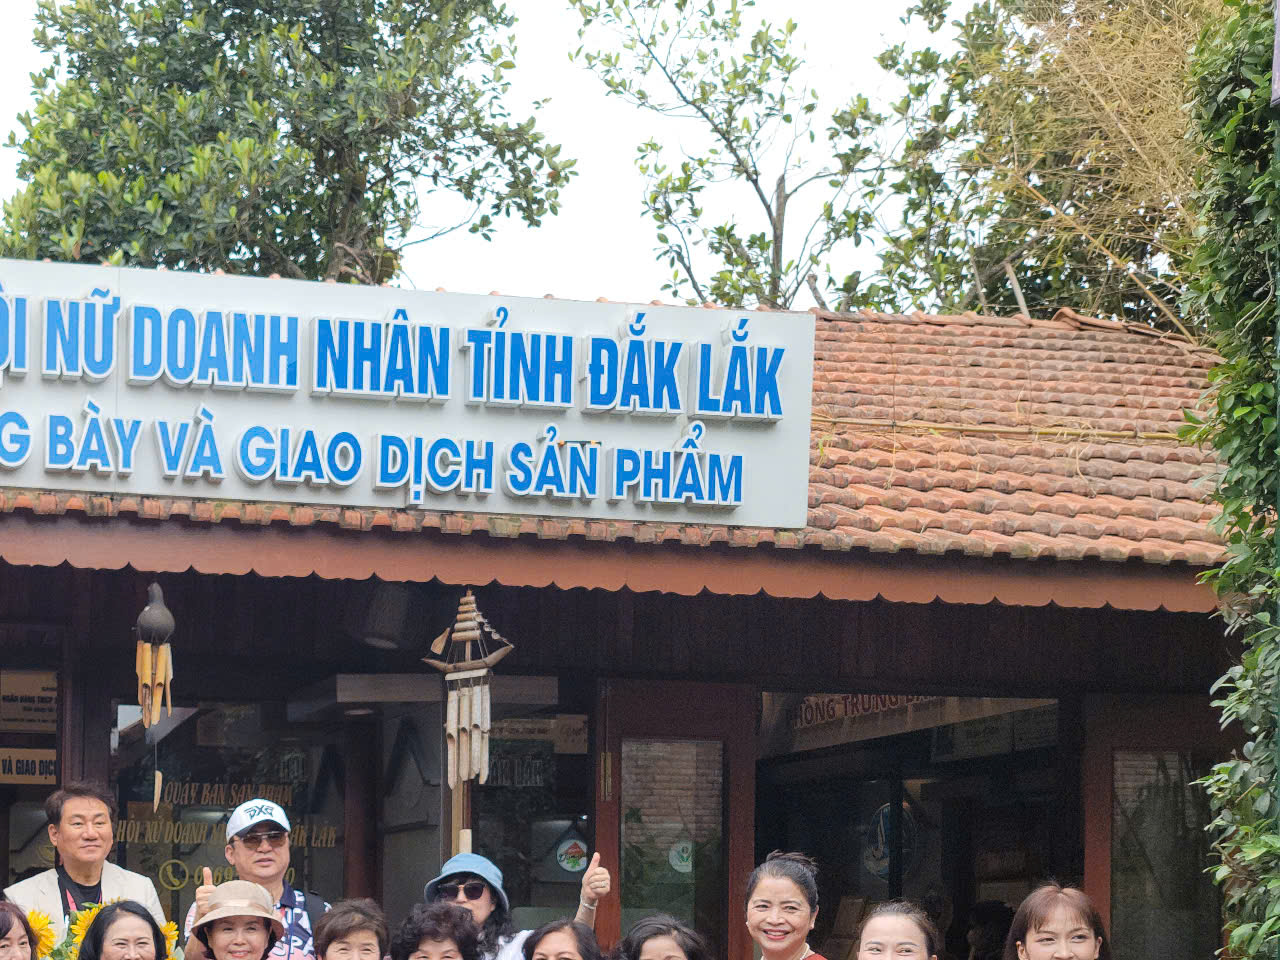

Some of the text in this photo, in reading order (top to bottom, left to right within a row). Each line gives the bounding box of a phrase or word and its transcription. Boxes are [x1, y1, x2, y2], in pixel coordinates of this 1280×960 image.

[44, 287, 121, 376] NỮ
[132, 305, 299, 387] DOANH
[315, 308, 450, 397] NHÂN
[466, 306, 573, 405] TỈNH
[587, 312, 683, 411] ĐẮK
[696, 318, 785, 417] LẮK
[48, 401, 142, 470] BÀY
[157, 407, 223, 475] VÀ
[238, 425, 362, 483] GIAO
[378, 434, 494, 502] DỊCH
[508, 425, 598, 496] SẢN
[614, 423, 743, 504] PHẨM
[1, 755, 13, 775] VÀ
[15, 759, 36, 776] GIAO
